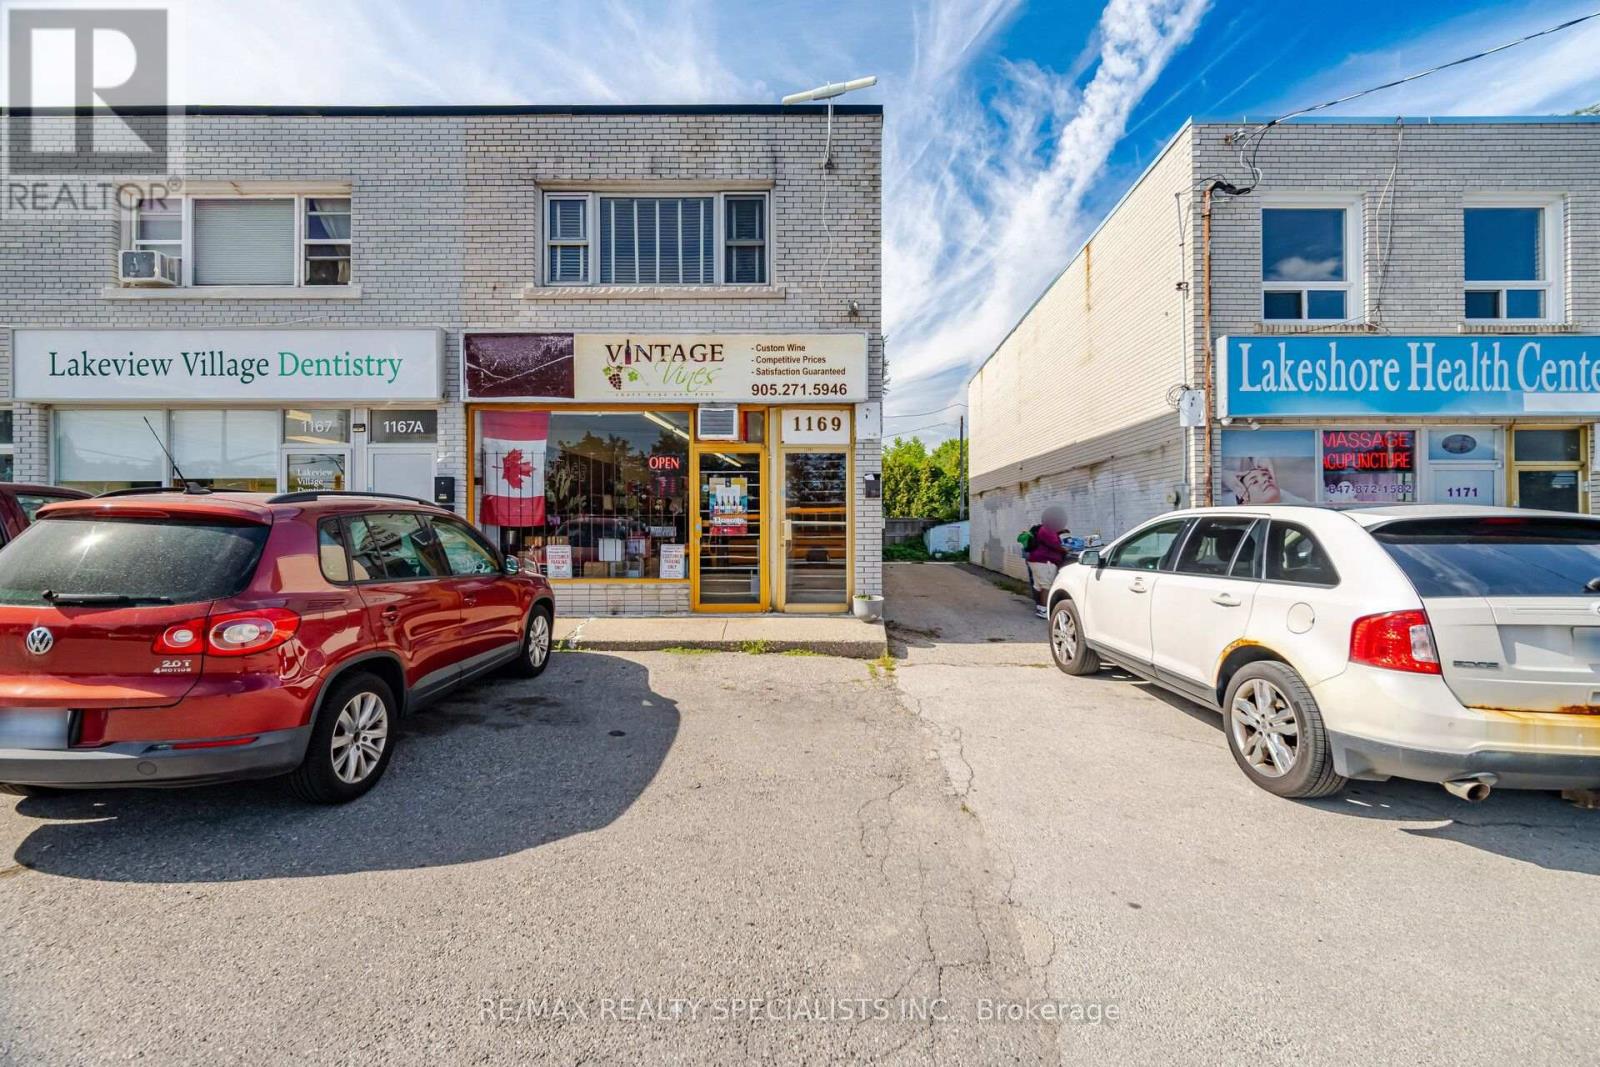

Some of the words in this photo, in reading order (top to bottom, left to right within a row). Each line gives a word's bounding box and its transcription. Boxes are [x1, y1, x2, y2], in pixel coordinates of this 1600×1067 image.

[756, 344, 785, 352] Custom
[787, 344, 806, 352] Wine
[756, 356, 800, 365] Competitive
[802, 356, 826, 364] Prices
[1239, 342, 1400, 392] Lakeshore
[1407, 342, 1512, 392] Health
[49, 351, 173, 377] Lakeview
[181, 351, 270, 384] Village
[278, 351, 403, 384] Dentistry
[756, 367, 800, 376] Satisfaction
[802, 367, 846, 376] Guaranteed
[654, 357, 722, 392] Vines
[751, 383, 848, 396] 905.271.5946
[302, 420, 333, 433] 1167
[383, 420, 424, 433] 1167A
[793, 416, 842, 432] 1169
[649, 456, 680, 469] OPEN
[297, 477, 324, 487] Village
[1447, 487, 1478, 497] 1171
